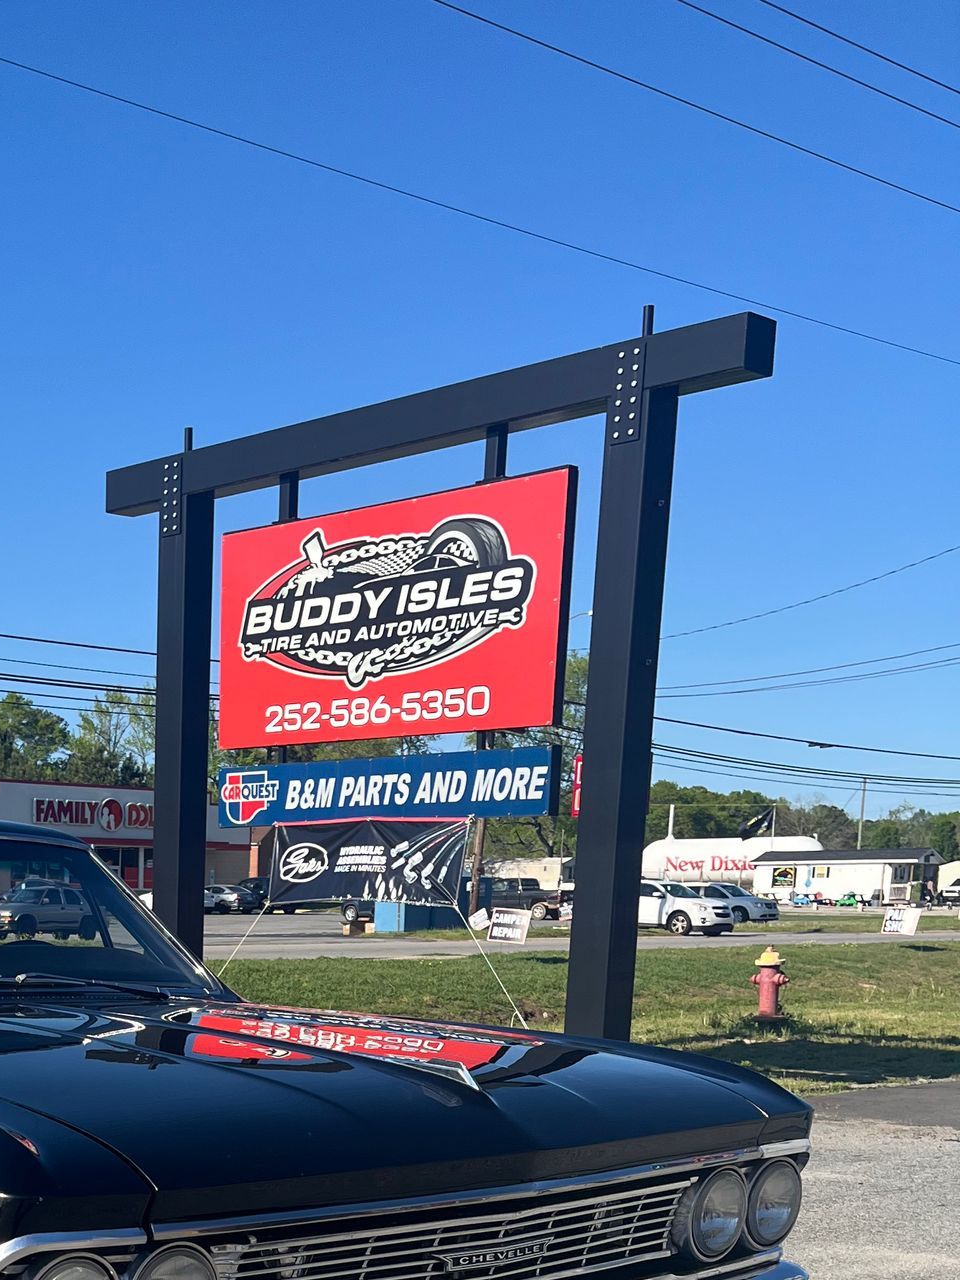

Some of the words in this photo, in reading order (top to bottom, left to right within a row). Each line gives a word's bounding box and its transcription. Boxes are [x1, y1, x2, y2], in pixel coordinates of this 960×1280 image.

[246, 587, 394, 635] BUDDY
[396, 567, 525, 615] ISLES
[260, 634, 303, 652] TIRE
[305, 628, 351, 647] AND
[354, 608, 499, 641] AUTOMOTIVE
[264, 685, 491, 733] 252-586-5350
[222, 783, 278, 801] CARQUEST
[285, 777, 336, 810] B&M
[338, 772, 412, 807] PARTS
[413, 770, 468, 804] AND
[471, 766, 549, 802] MORE
[34, 798, 100, 825] FAMILY
[126, 803, 154, 828] DOL
[282, 848, 324, 878] Gates
[334, 865, 350, 873] MADE
[350, 864, 358, 872] IN
[358, 864, 387, 873] MINUTES
[665, 856, 704, 872] New
[491, 926, 522, 940] REPAIR
[459, 1244, 541, 1265] CHEVELLE
